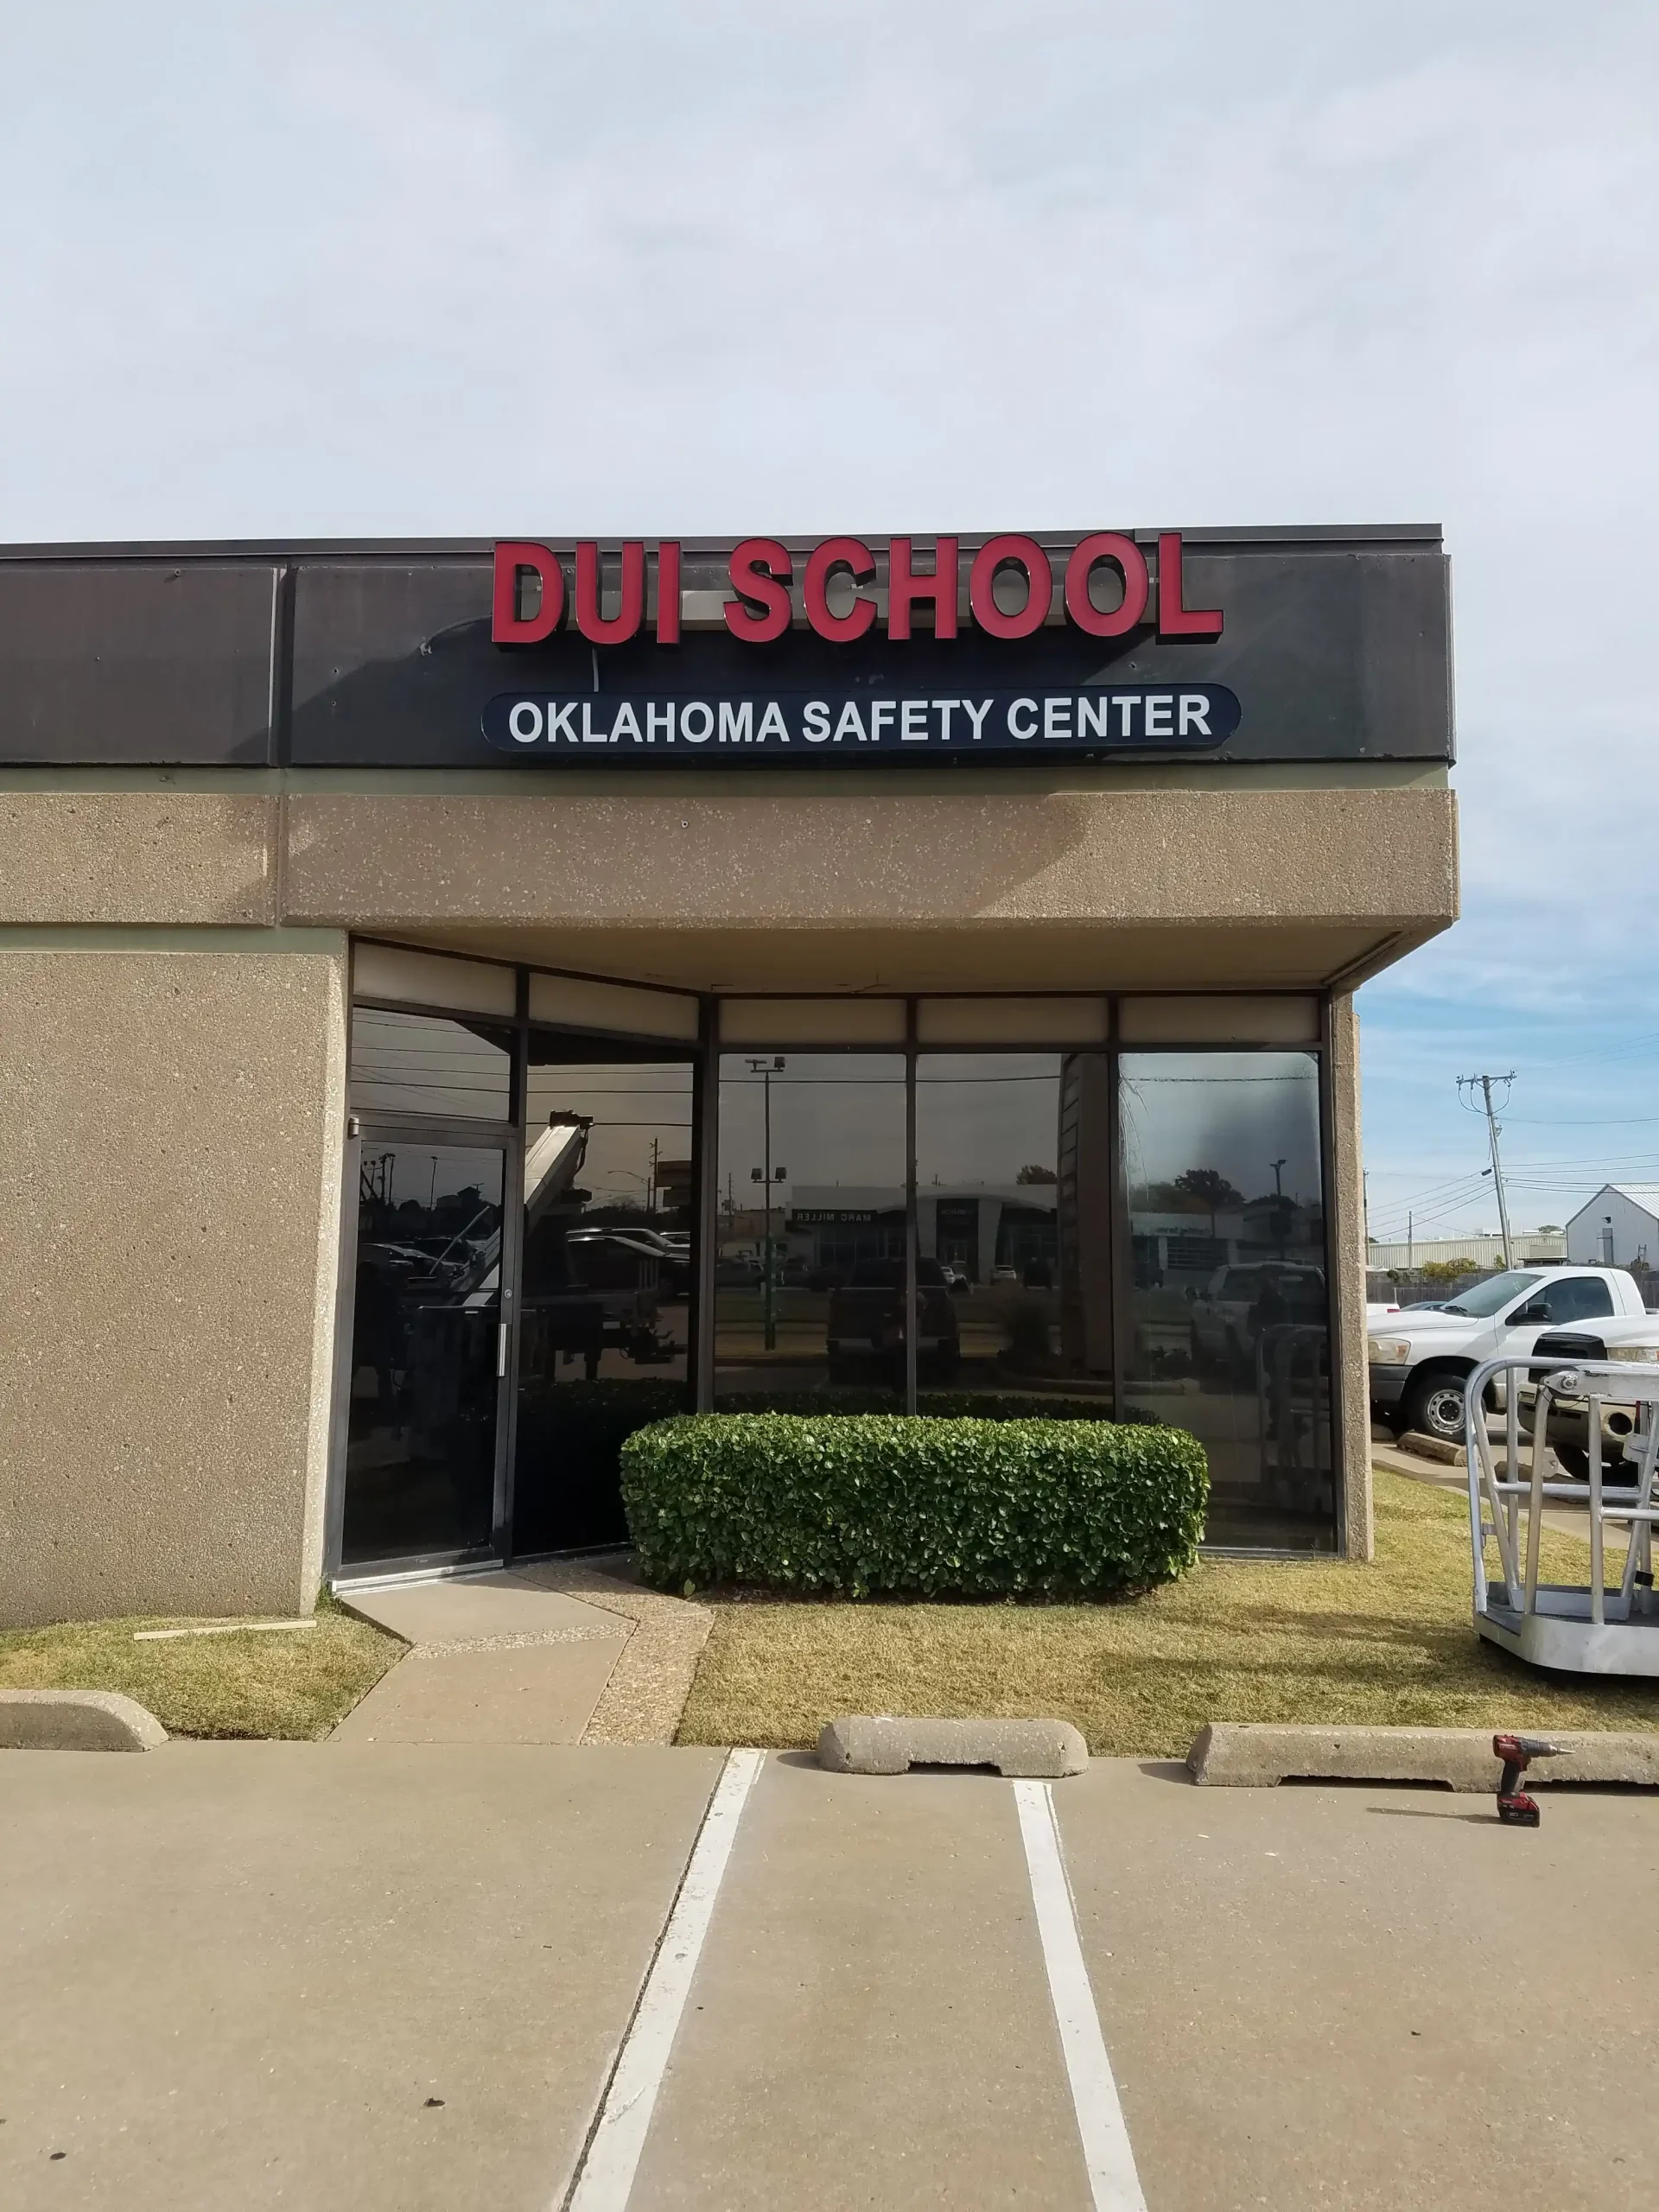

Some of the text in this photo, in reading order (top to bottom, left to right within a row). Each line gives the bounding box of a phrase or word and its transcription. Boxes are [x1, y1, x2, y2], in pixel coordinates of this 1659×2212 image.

[492, 532, 1224, 644] DUI SCHOOL
[508, 695, 1211, 744] OKLAHOMA SAFETY CENTER
